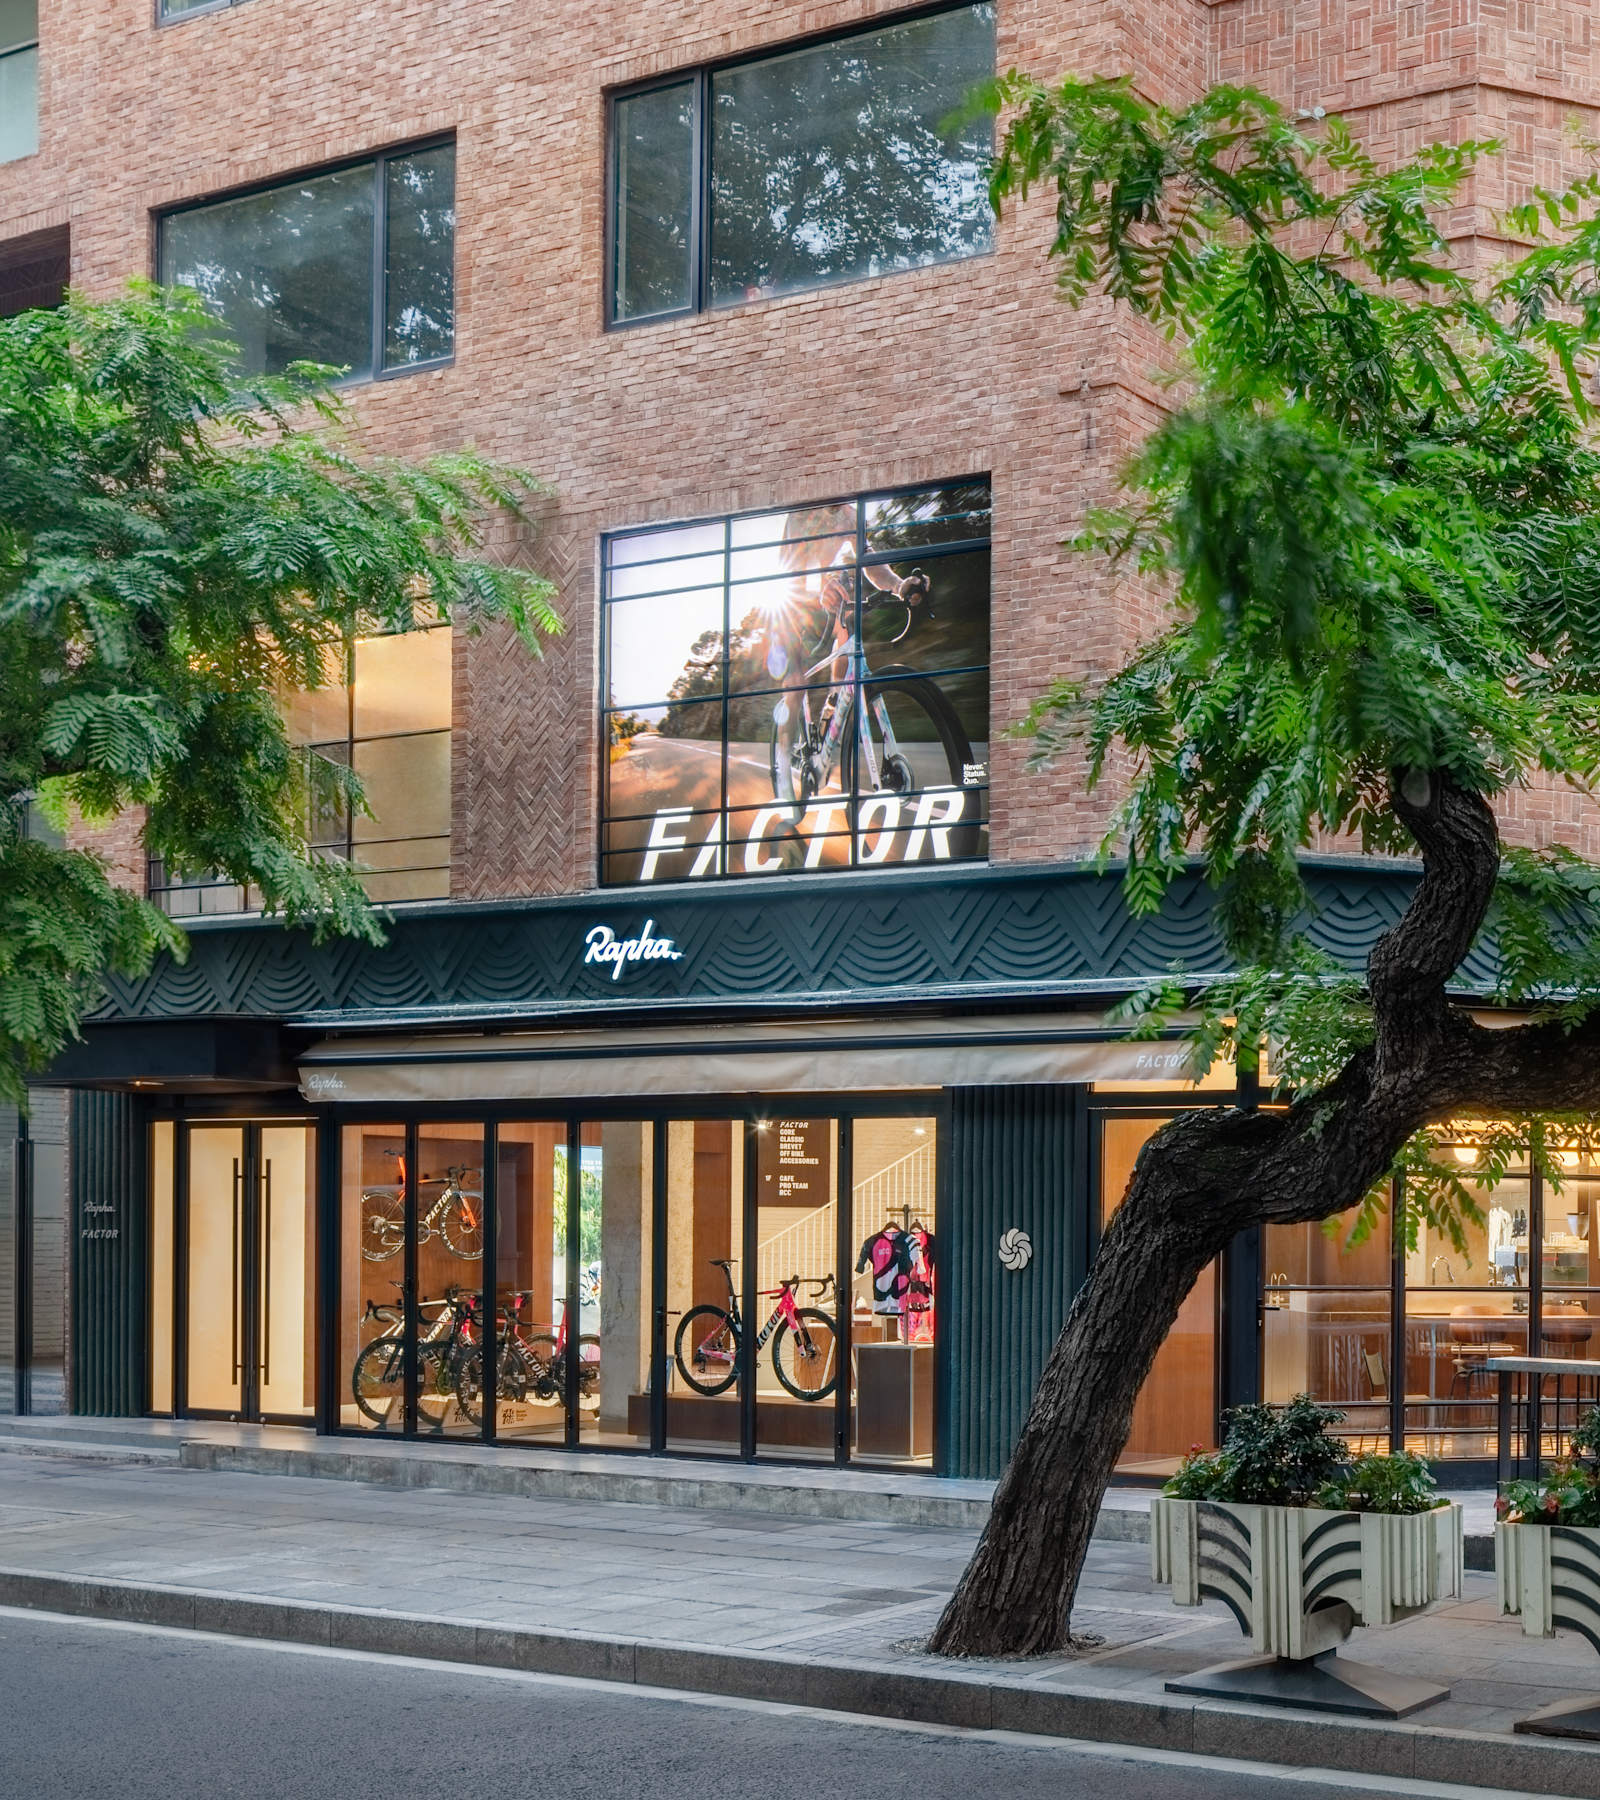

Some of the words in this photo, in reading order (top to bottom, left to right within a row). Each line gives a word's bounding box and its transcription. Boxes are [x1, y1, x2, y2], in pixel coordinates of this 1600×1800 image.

[638, 784, 966, 881] FACTOR
[779, 1121, 809, 1129] FACTOR
[791, 1182, 809, 1190] TEAM
[778, 1189, 792, 1197] RCC
[424, 1187, 453, 1225] FACTOR
[81, 1229, 119, 1239] FACTOR
[514, 1339, 547, 1379] FACTOR
